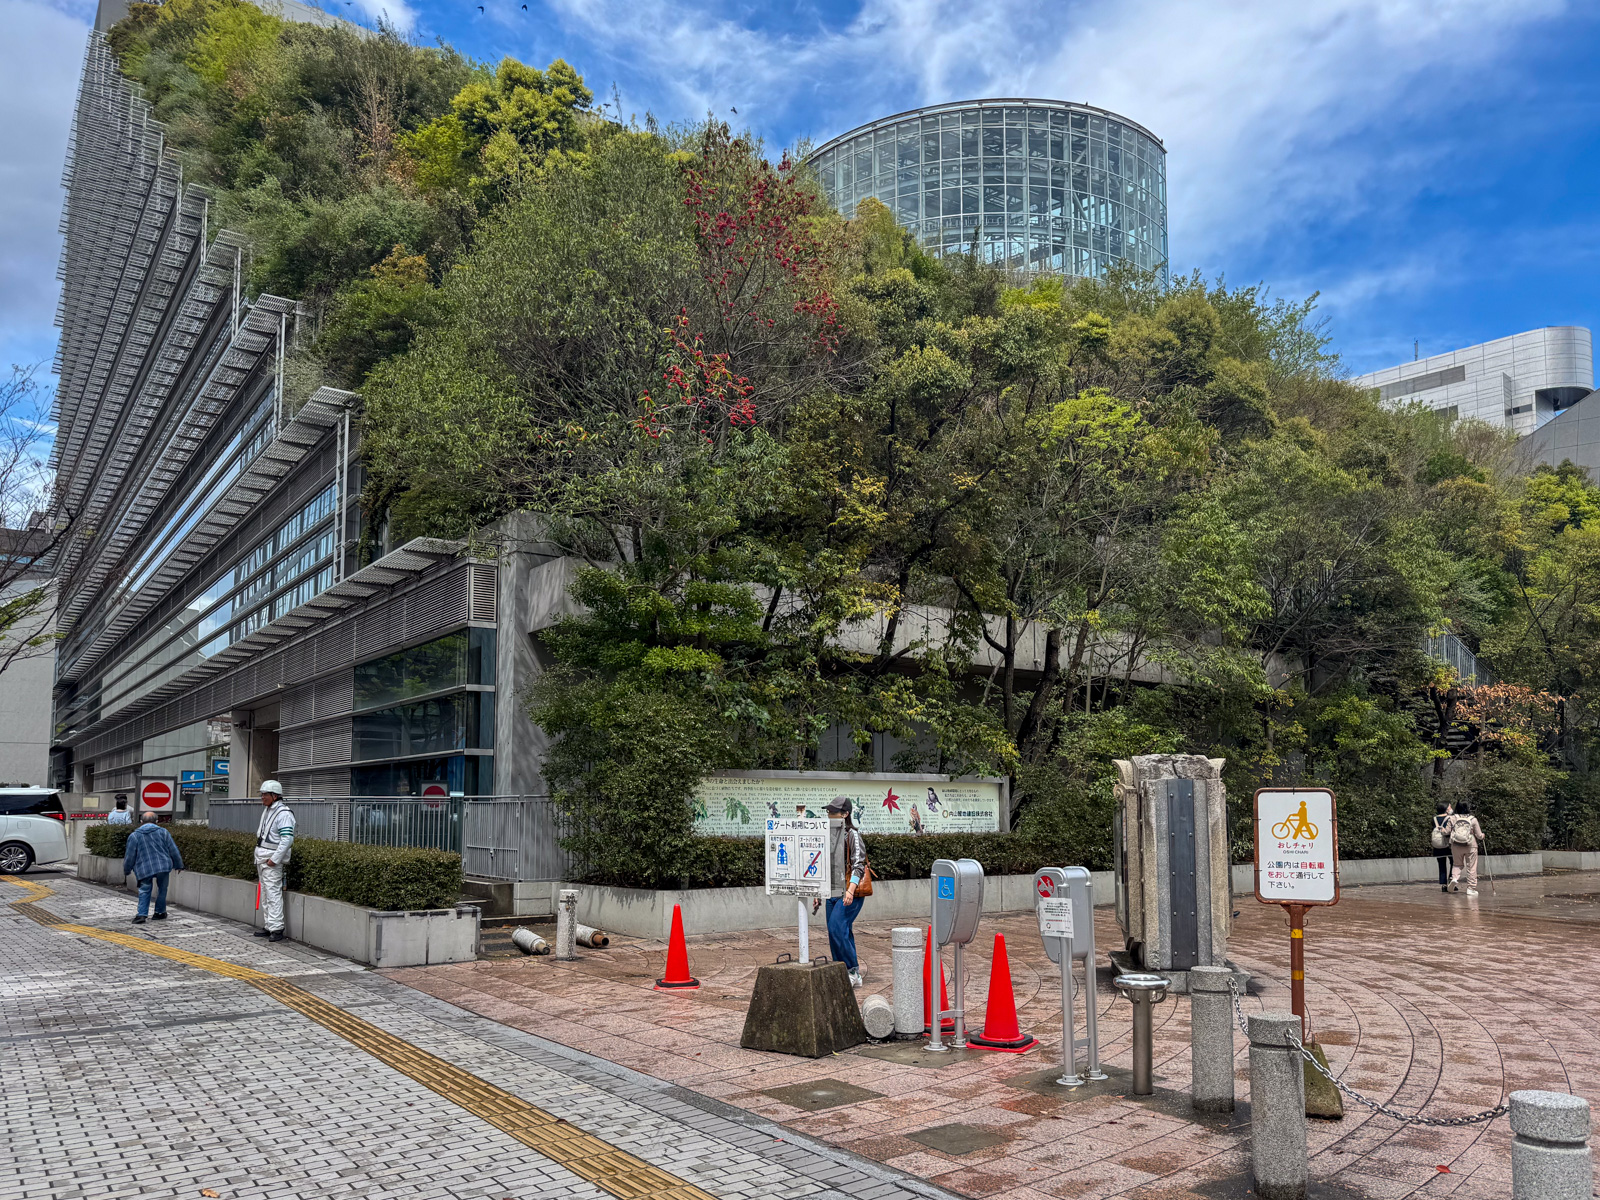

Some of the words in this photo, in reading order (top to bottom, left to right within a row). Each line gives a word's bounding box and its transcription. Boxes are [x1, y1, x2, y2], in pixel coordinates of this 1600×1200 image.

[774, 820, 828, 830] ゲート利用について
[1267, 861, 1325, 869] 公園内は自転車
[1268, 871, 1325, 879] をおして通行して
[1268, 881, 1295, 889] 下さい。
